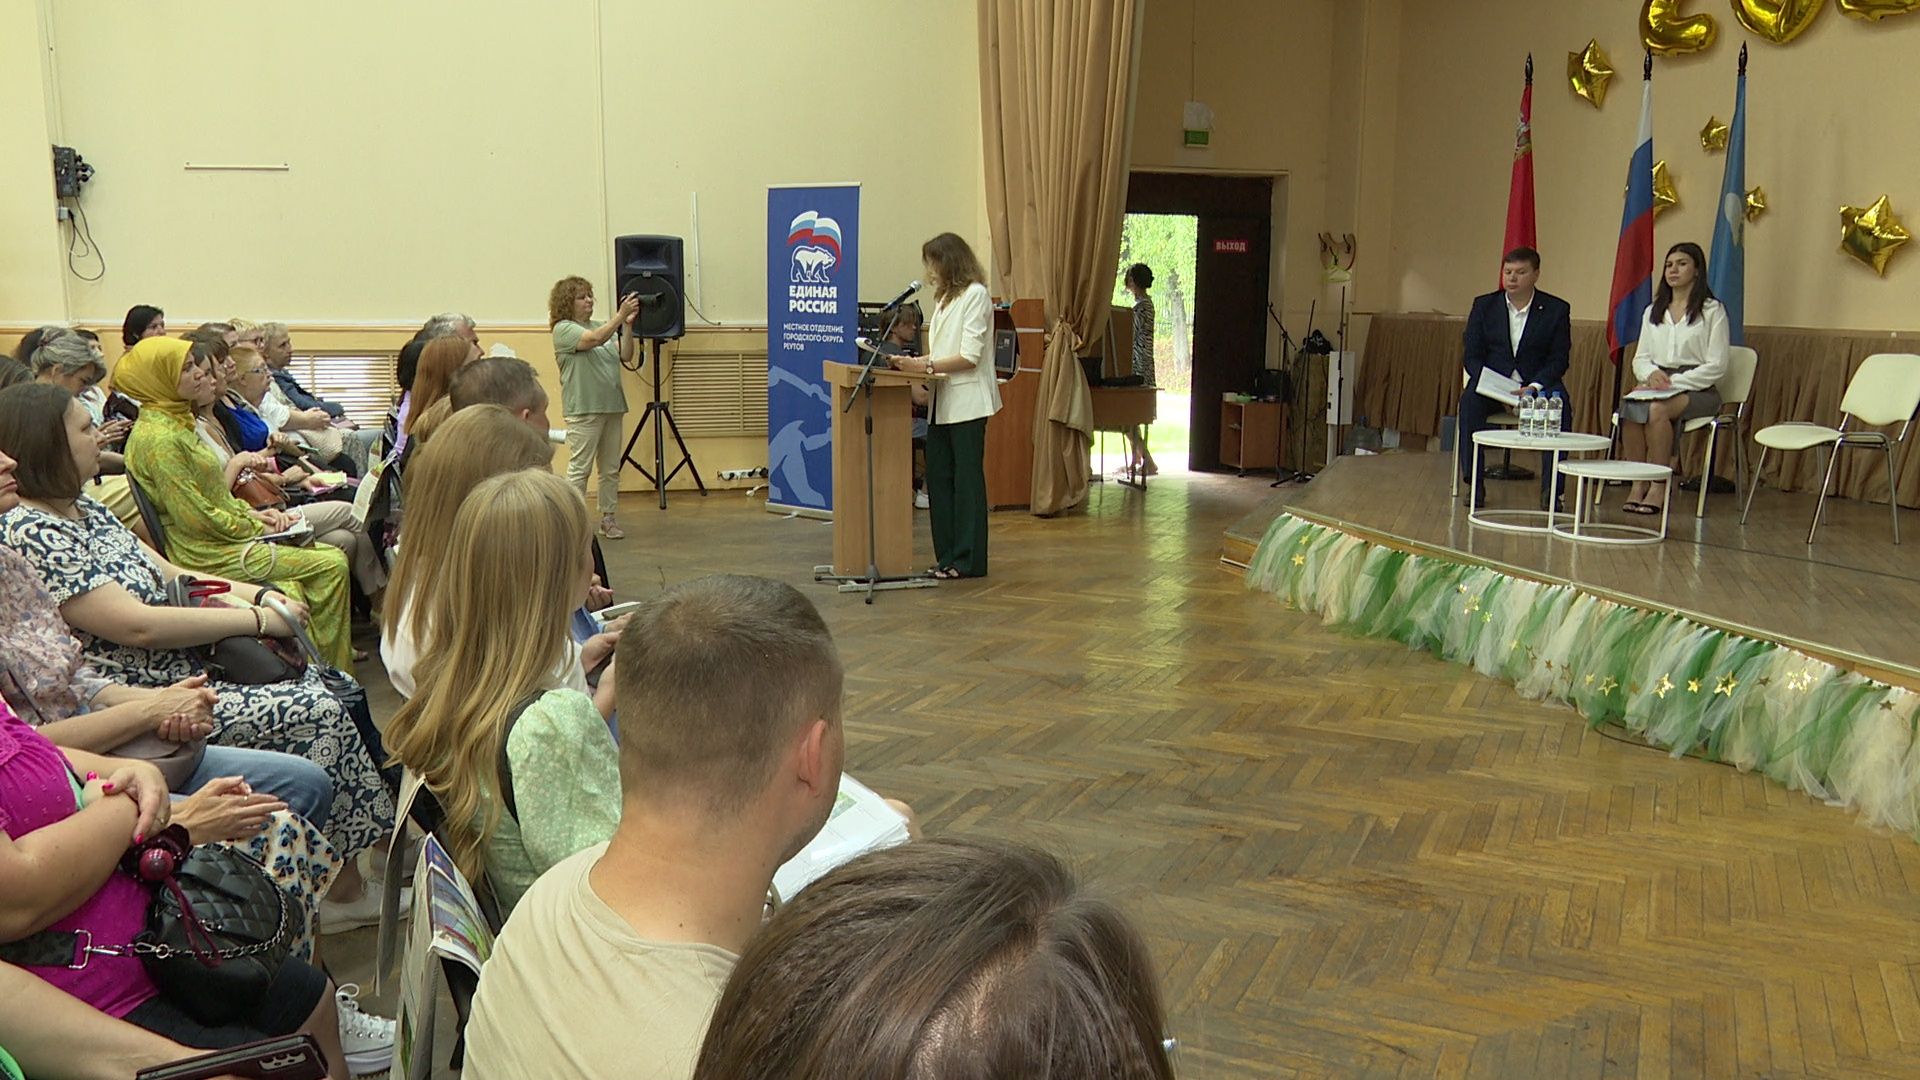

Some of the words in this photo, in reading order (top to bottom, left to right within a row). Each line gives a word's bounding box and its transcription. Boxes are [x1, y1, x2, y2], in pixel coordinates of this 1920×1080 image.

[1216, 241, 1246, 252] ВЫХОД
[789, 285, 837, 298] ЕДИНАЯ
[789, 300, 837, 314] РОССИЯ
[783, 323, 809, 331] МЕСТНОЕ
[809, 324, 844, 333] ОТДЕЛЕНИЕ
[783, 333, 821, 342] ГОРОДСКОГО
[822, 335, 844, 343] ОКРУГА
[783, 342, 805, 351] РЕУТОВ
